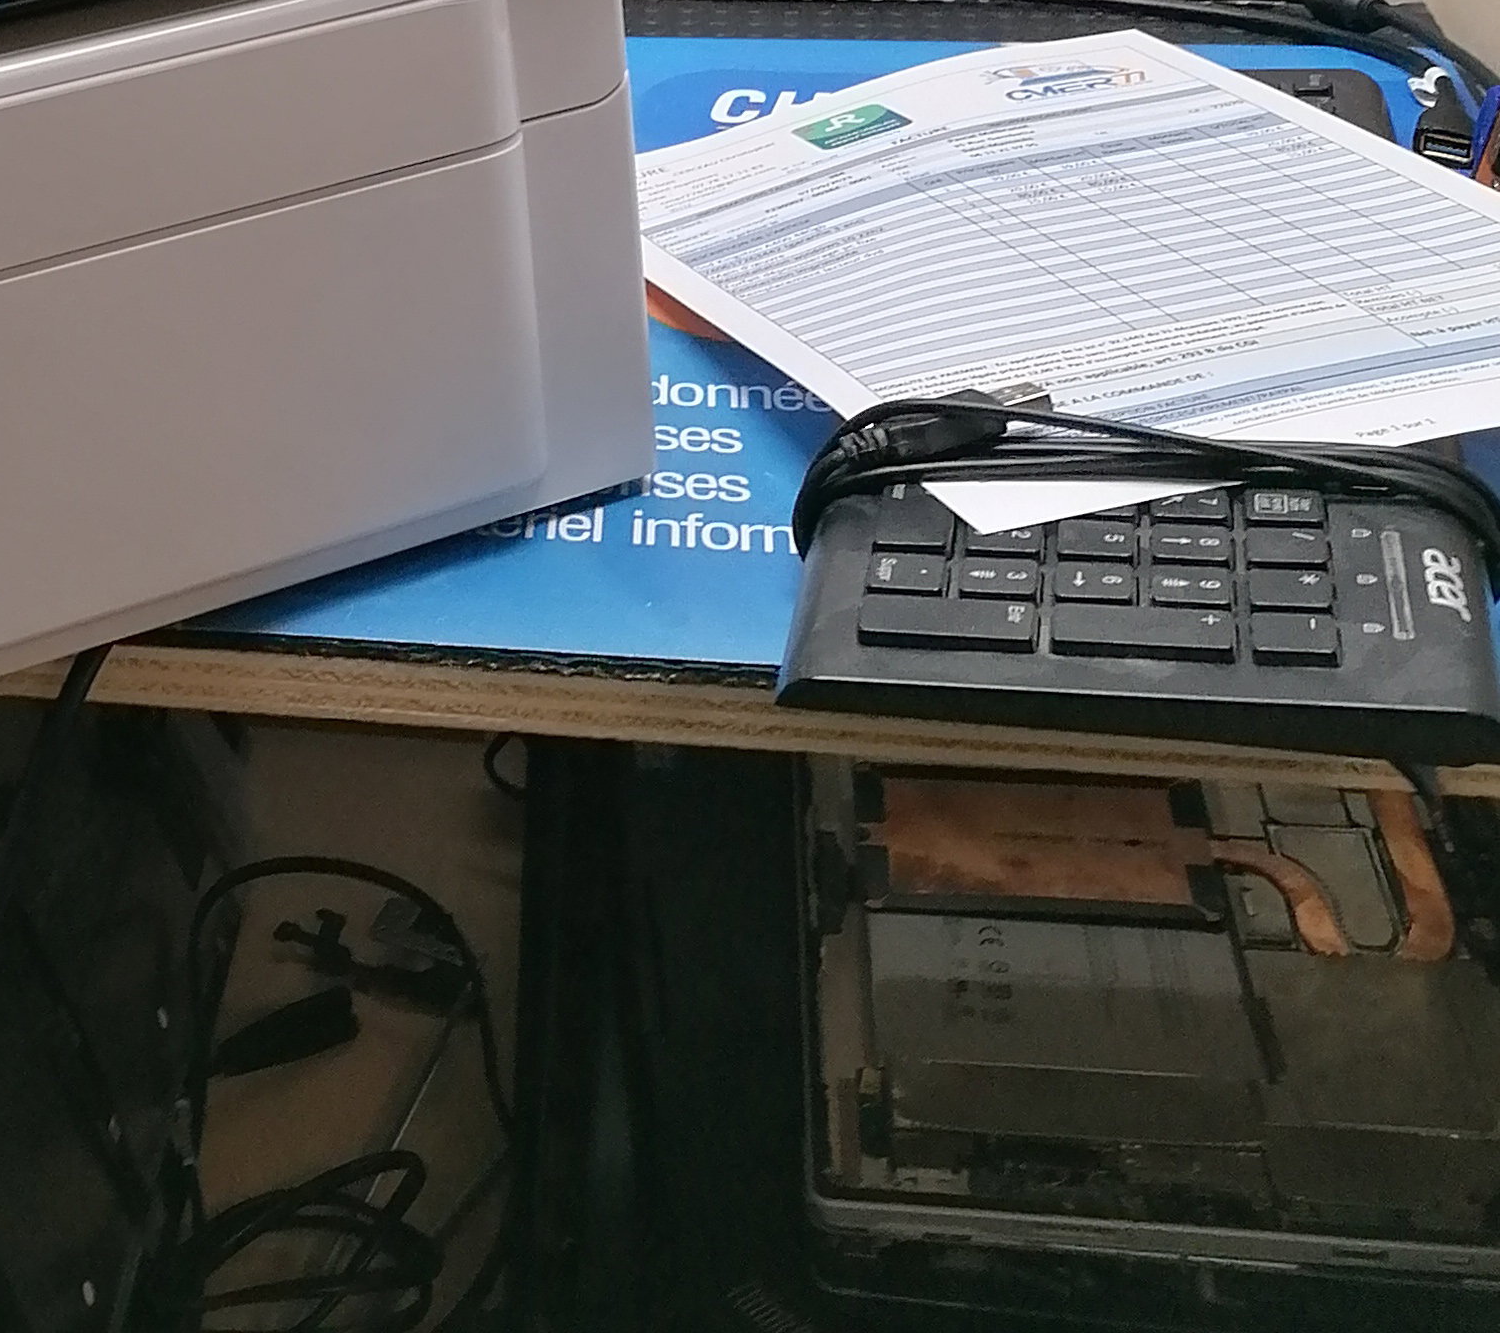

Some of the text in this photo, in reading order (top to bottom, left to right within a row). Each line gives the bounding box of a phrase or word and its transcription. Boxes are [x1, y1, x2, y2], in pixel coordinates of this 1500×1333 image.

[1102, 532, 1126, 543] 5
[1199, 536, 1221, 547] 8
[1006, 570, 1029, 581] 3
[1101, 574, 1124, 586] 6
[1198, 579, 1223, 590] 9
[1420, 546, 1473, 624] acer
